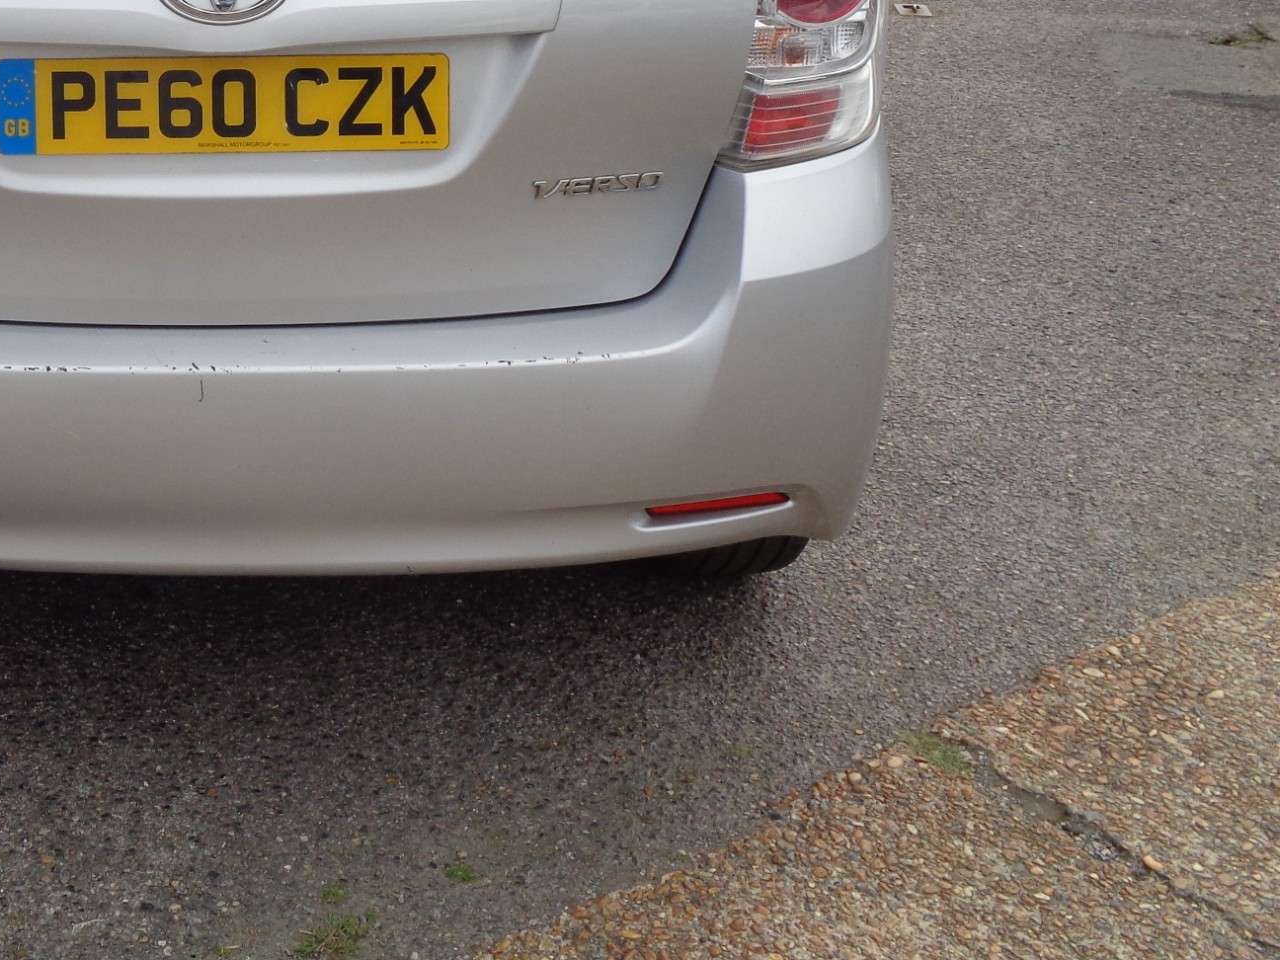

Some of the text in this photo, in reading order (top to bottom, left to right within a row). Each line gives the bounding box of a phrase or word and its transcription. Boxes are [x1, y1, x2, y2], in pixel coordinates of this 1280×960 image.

[51, 66, 437, 140] PE60 CZK
[4, 119, 30, 137] GB
[532, 171, 664, 200] VERSO
